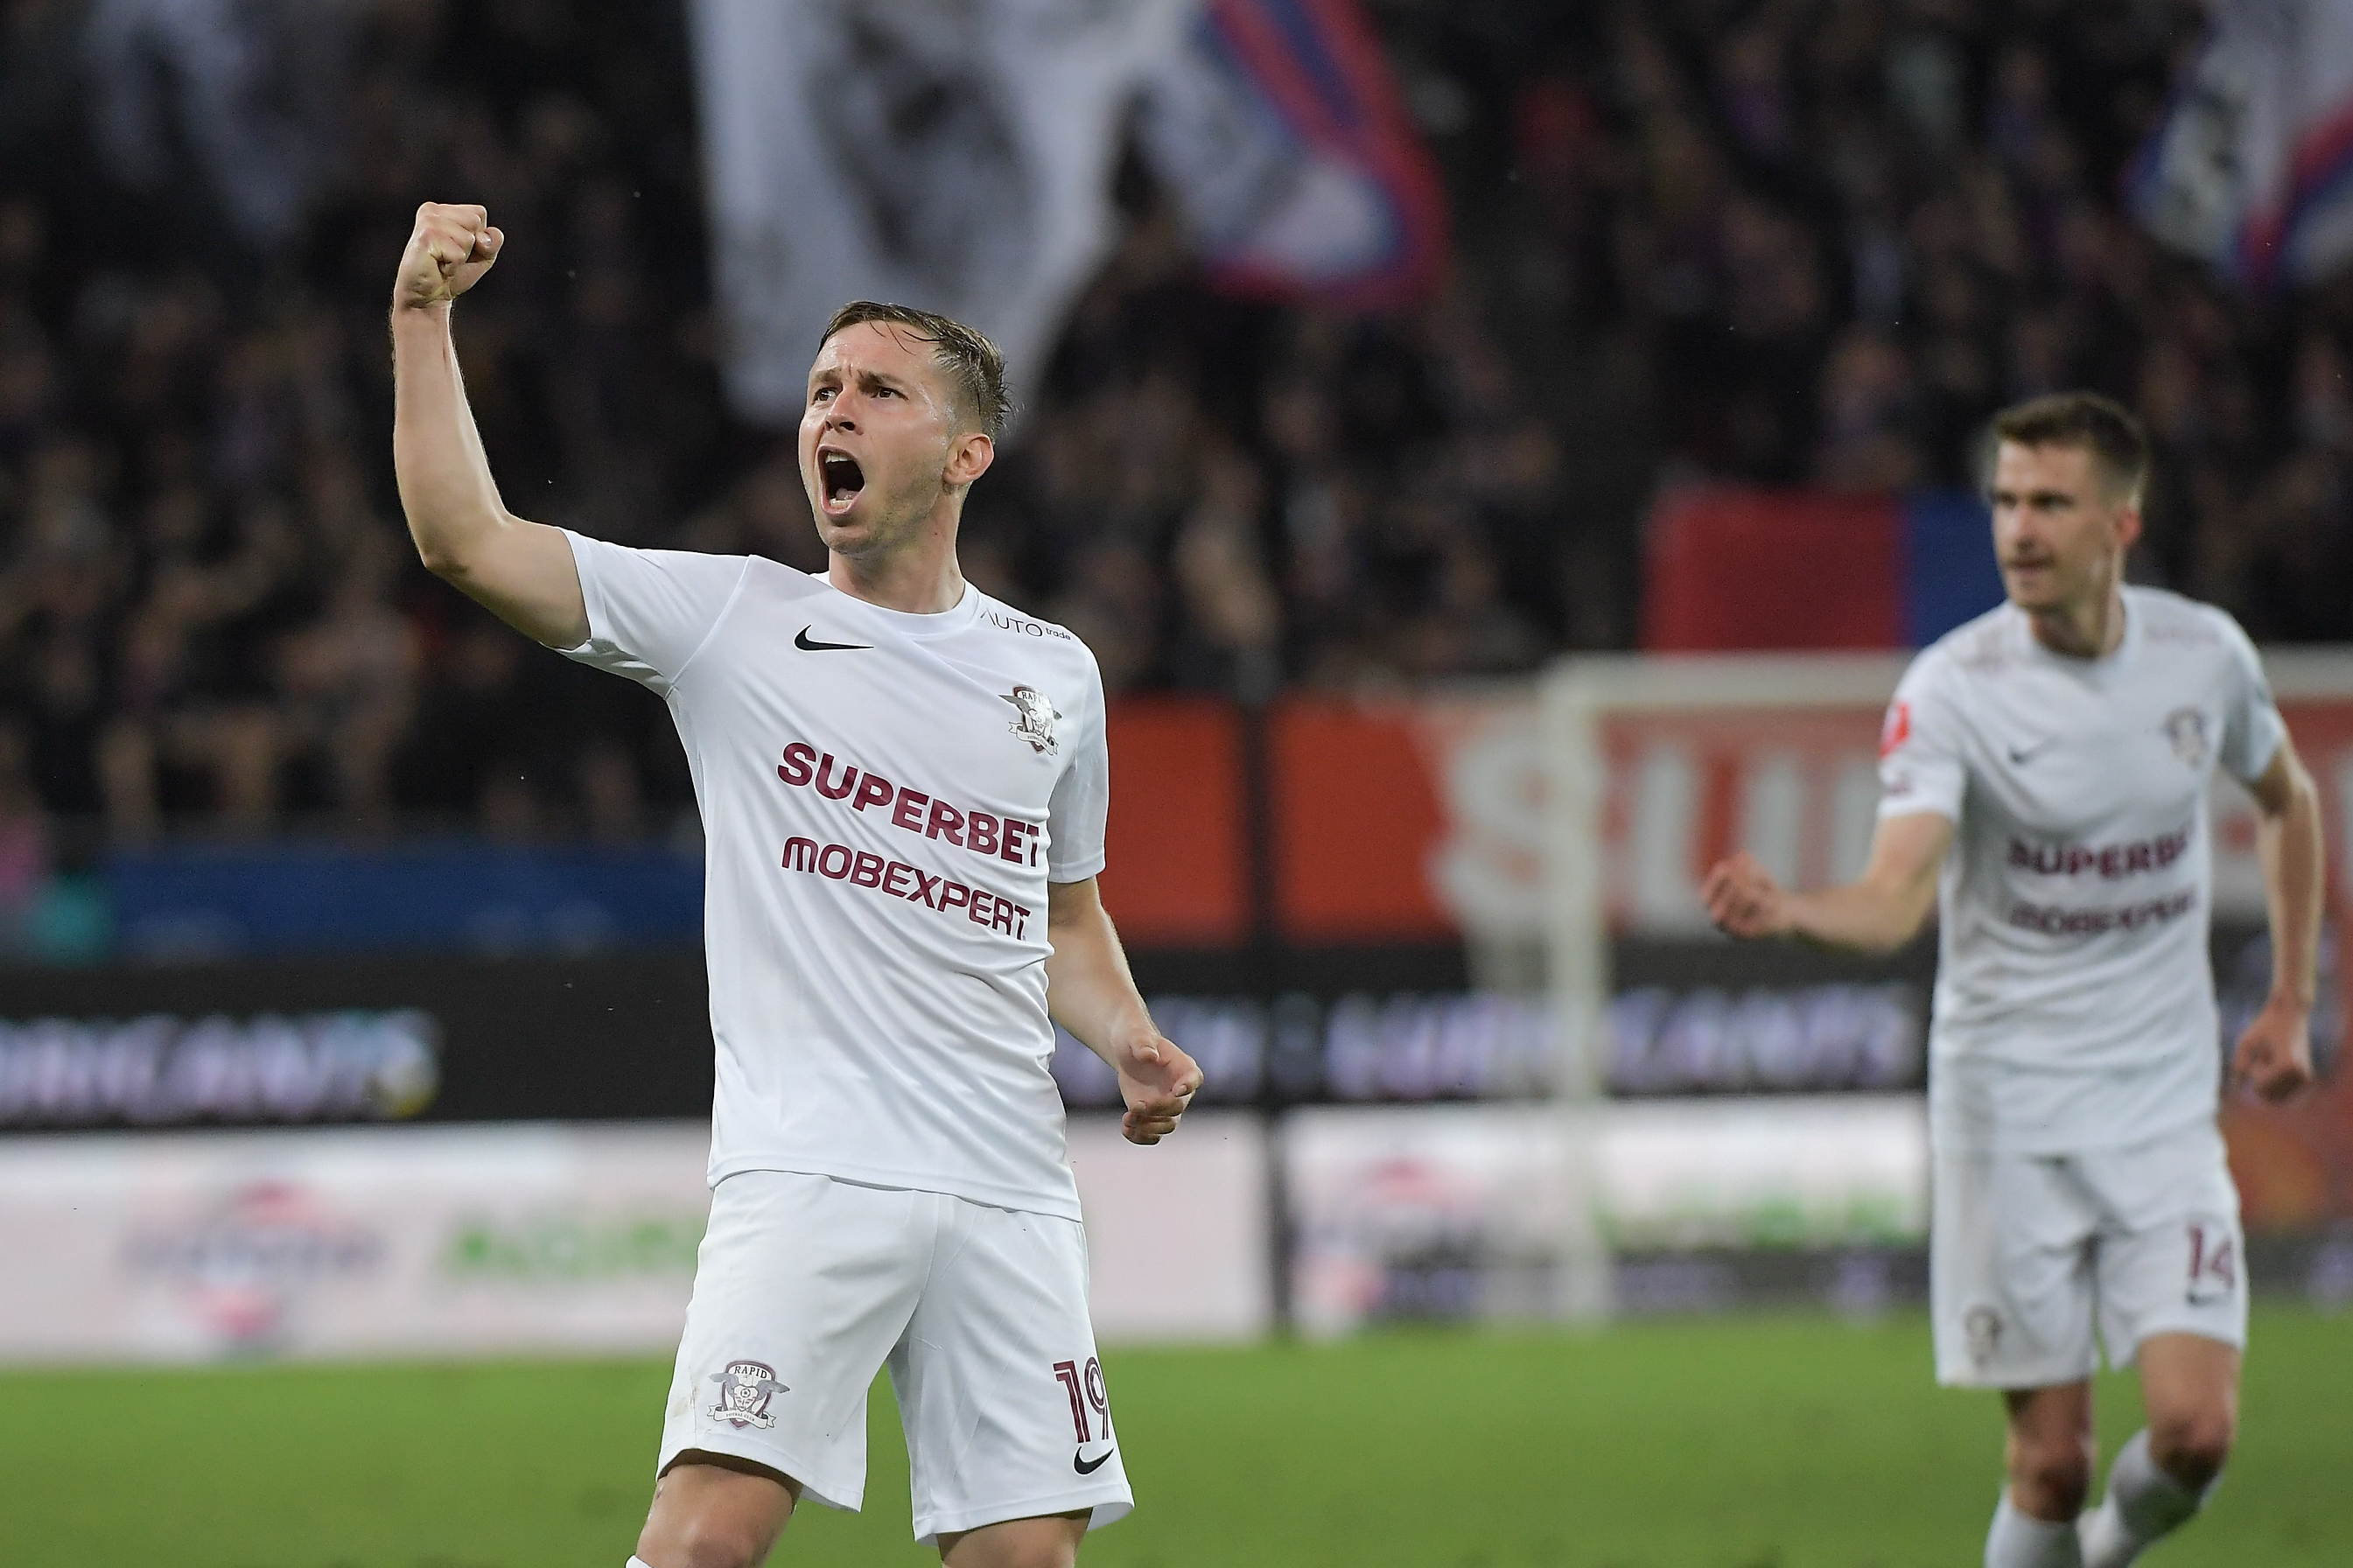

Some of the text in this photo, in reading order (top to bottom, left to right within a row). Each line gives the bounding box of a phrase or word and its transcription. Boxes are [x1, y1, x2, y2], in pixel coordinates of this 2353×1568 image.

[980, 608, 1071, 640] AUTO trade
[778, 743, 1040, 867] SUPERBET
[782, 836, 1031, 941] MOBEXPERT
[2186, 1225, 2235, 1291] 14
[733, 1365, 767, 1379] RAPID
[1053, 1356, 1110, 1444] 19
